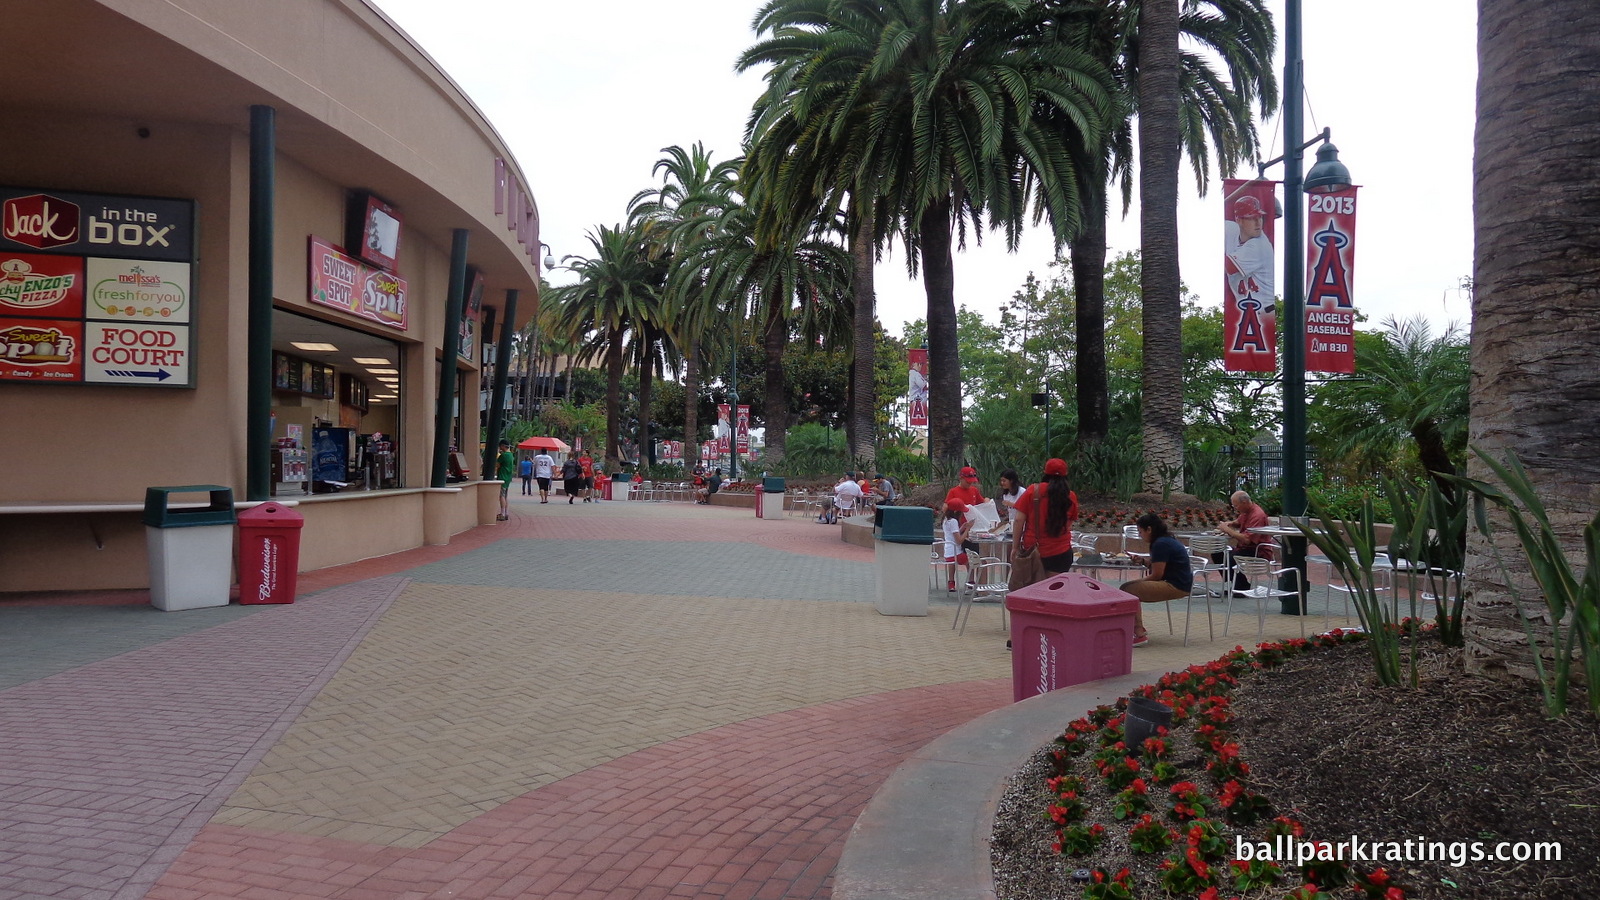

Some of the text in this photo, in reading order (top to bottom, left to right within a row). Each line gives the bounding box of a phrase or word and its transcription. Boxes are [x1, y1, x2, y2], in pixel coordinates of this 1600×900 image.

[103, 206, 158, 223] in the
[1311, 194, 1354, 215] 2013
[7, 201, 76, 241] Jack
[89, 215, 170, 247] box
[323, 254, 356, 285] SWEET
[1306, 219, 1353, 307] A
[23, 275, 73, 292] ENZO'S
[328, 279, 352, 306] SPOT
[376, 274, 399, 295] Sweet
[21, 290, 57, 303] PIZZA
[364, 280, 404, 315] Spot
[1233, 291, 1267, 351] A
[1308, 312, 1351, 325] ANGELS
[9, 329, 58, 342] Sweet
[101, 328, 176, 348] FOOD
[1307, 325, 1351, 336] BASEBALL
[0, 337, 72, 359] pot
[1311, 337, 1347, 352] AM 830
[92, 347, 184, 367] COURT
[259, 538, 271, 600] Budweiser
